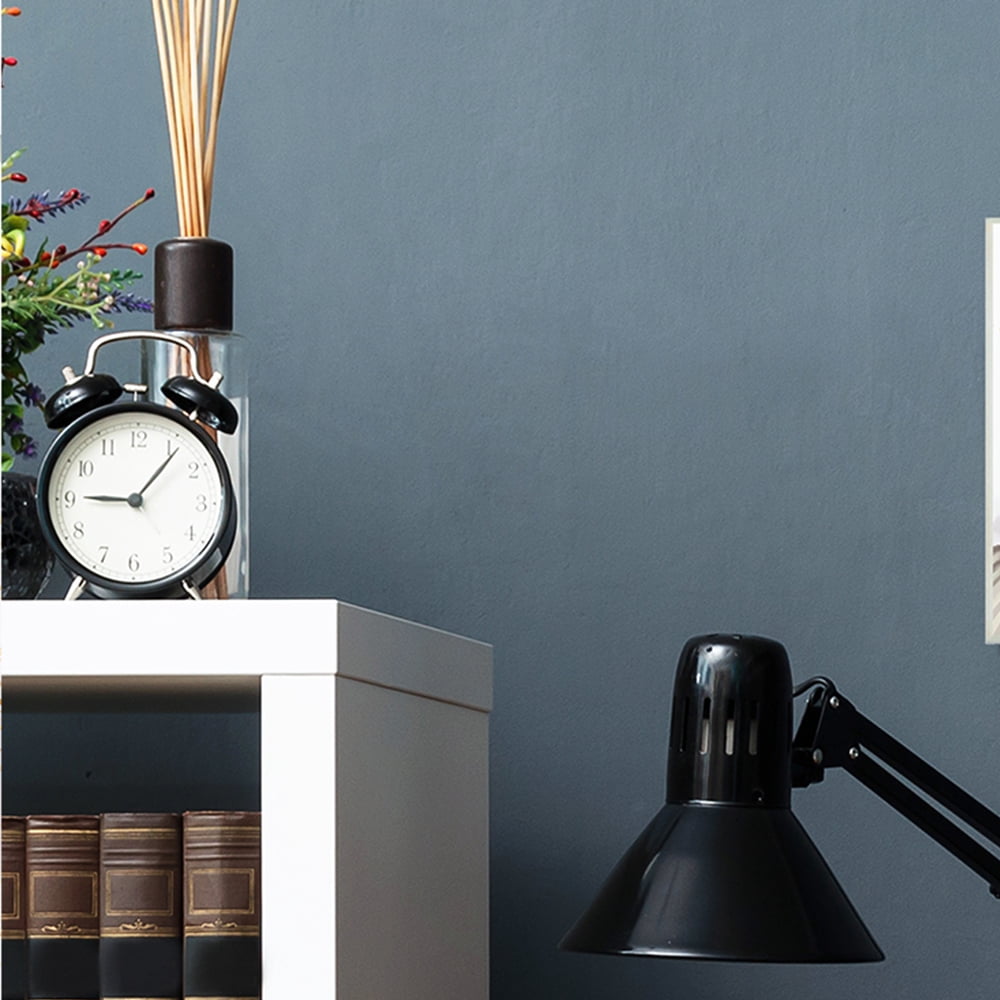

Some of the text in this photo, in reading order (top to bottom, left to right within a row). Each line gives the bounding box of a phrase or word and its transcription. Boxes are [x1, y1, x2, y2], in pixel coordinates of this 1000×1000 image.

[102, 439, 115, 456] 11
[130, 430, 148, 448] 12
[166, 440, 172, 456] 1
[78, 460, 94, 477] 10
[188, 462, 200, 479] 2
[64, 490, 76, 509] 9
[196, 495, 208, 512] 3
[73, 521, 85, 538] 8
[184, 525, 197, 542] 4
[98, 546, 109, 564] 7
[128, 553, 140, 571] 6
[163, 546, 174, 564] 5
